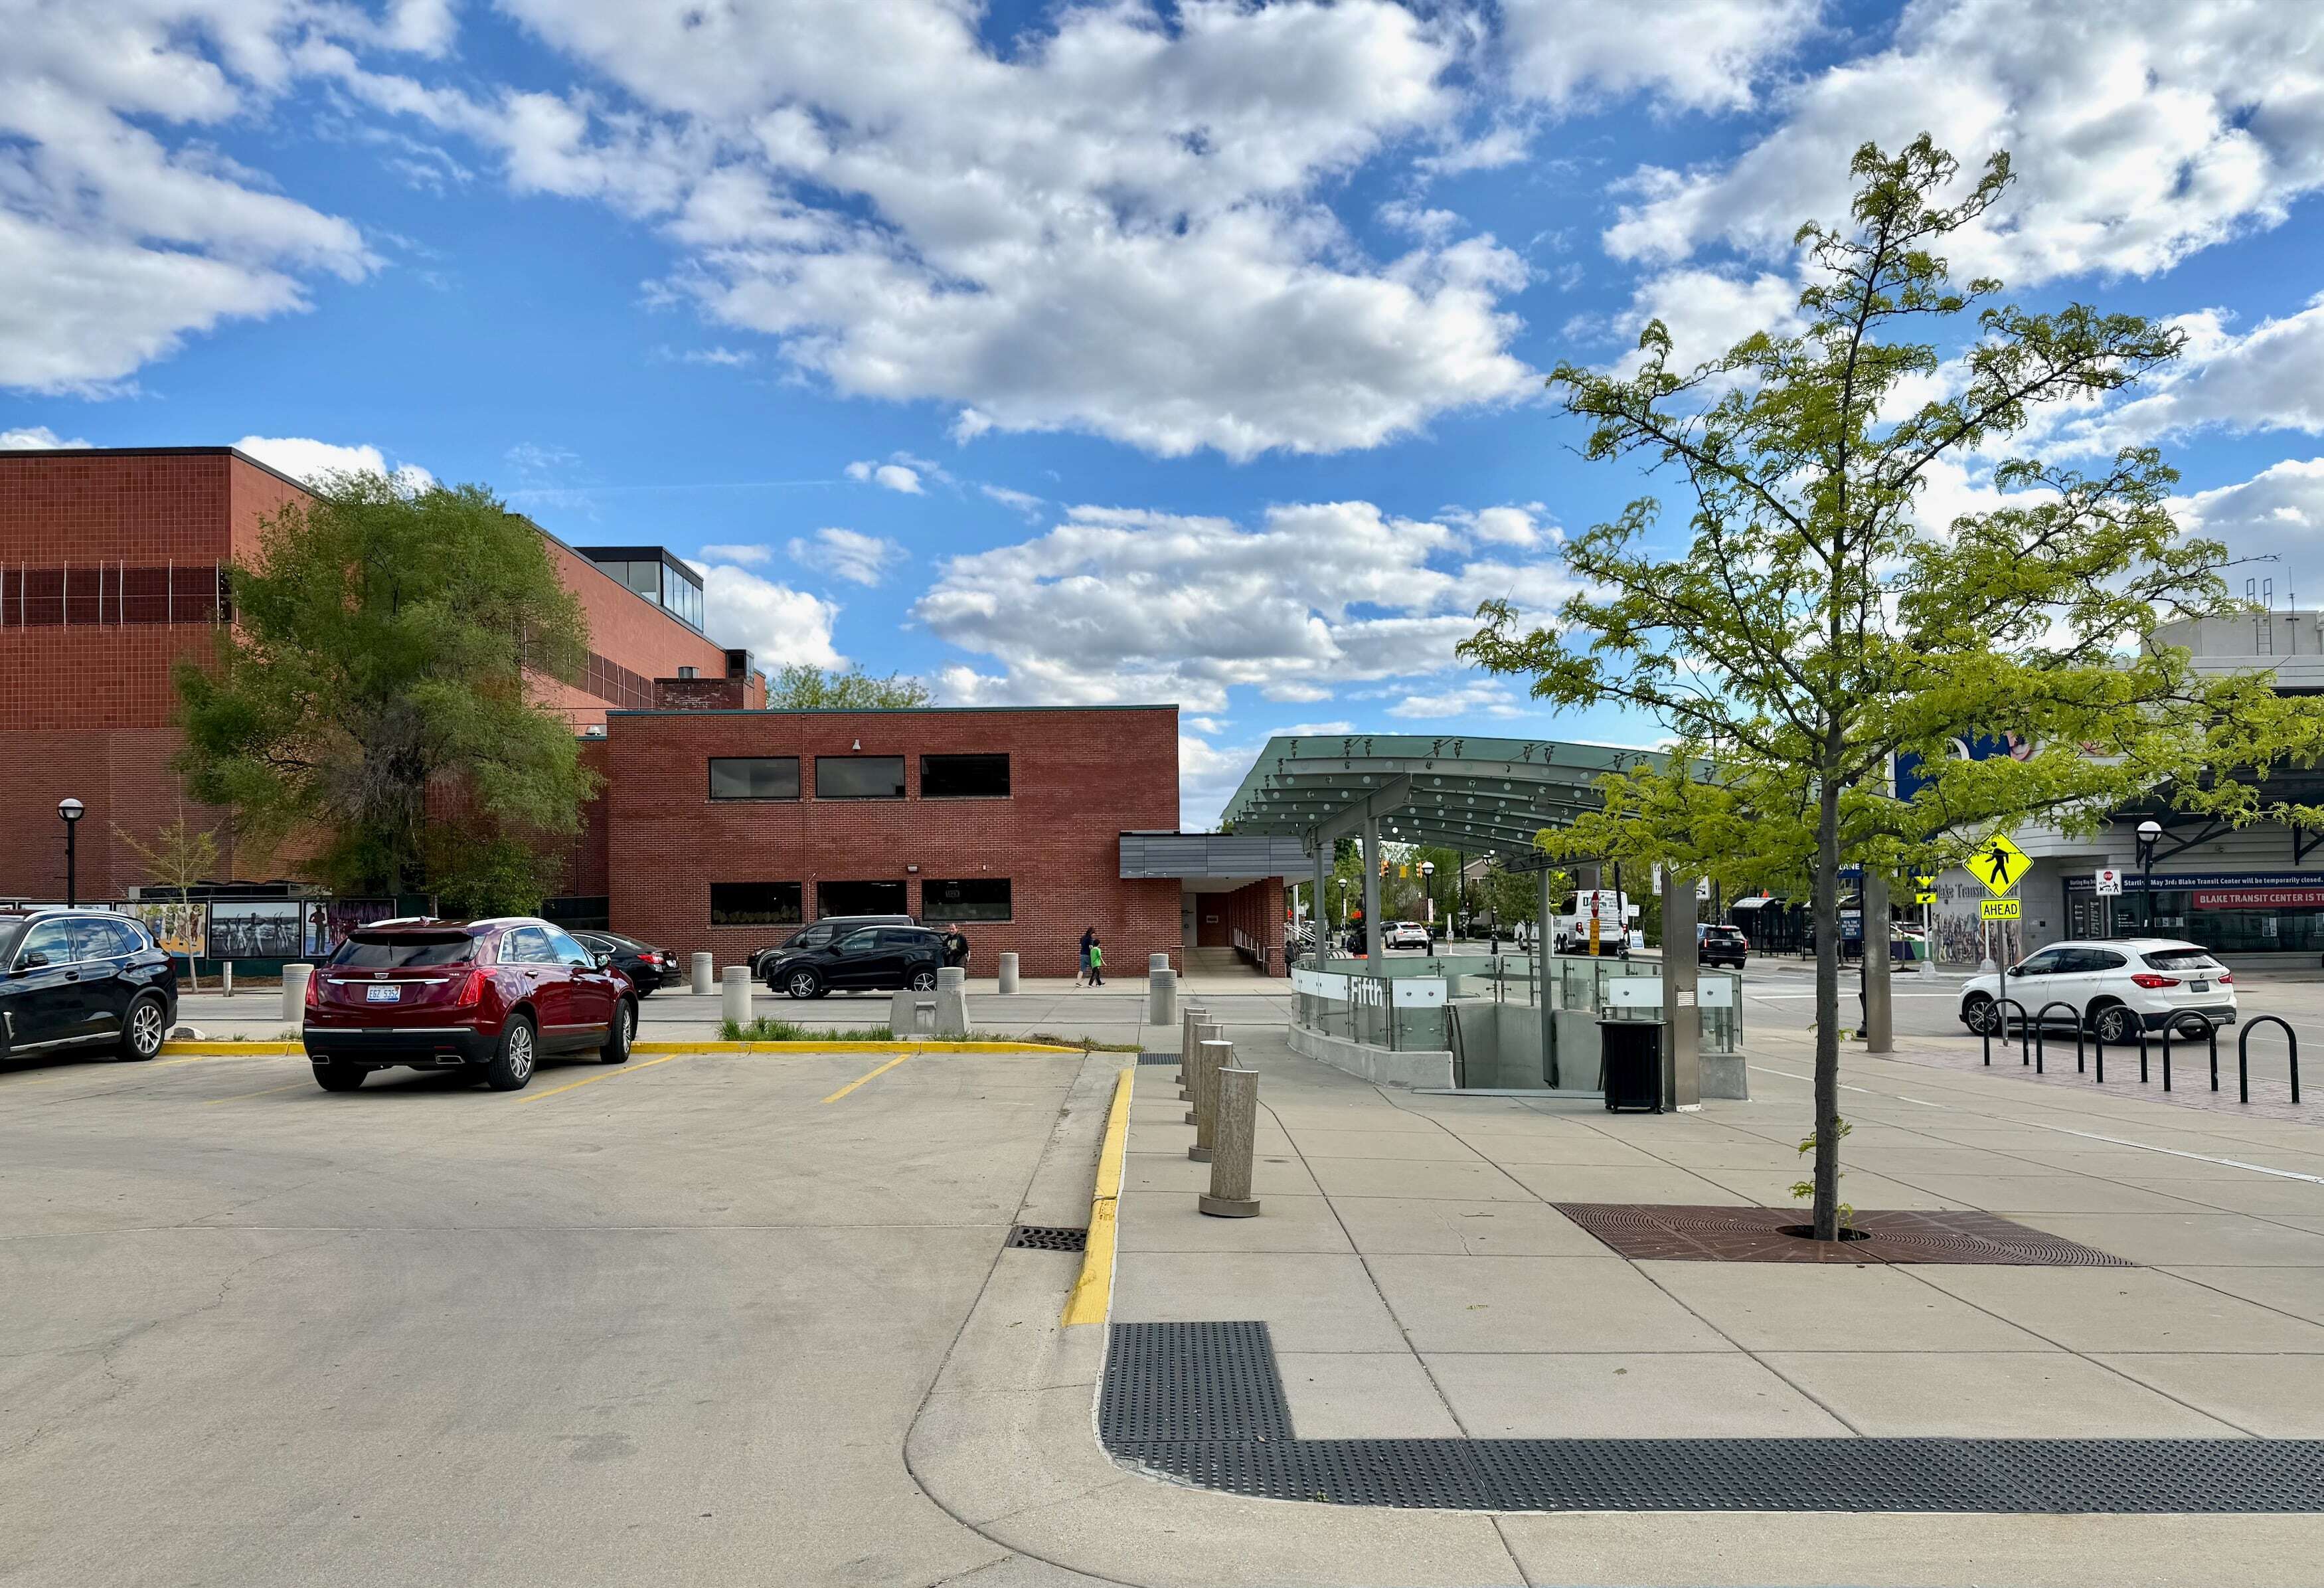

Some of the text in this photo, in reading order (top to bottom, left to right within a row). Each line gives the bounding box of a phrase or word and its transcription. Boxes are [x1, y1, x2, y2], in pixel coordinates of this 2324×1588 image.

[1955, 883, 1987, 898] Transit
[2200, 895, 2228, 904] BLAKE
[2230, 894, 2268, 903] TRANSIT
[2270, 893, 2303, 902] CENTER
[2305, 893, 2314, 902] IS
[1983, 904, 2018, 916] AHEAD
[369, 990, 380, 998] EGZ
[1351, 976, 1383, 1007] Fifth
